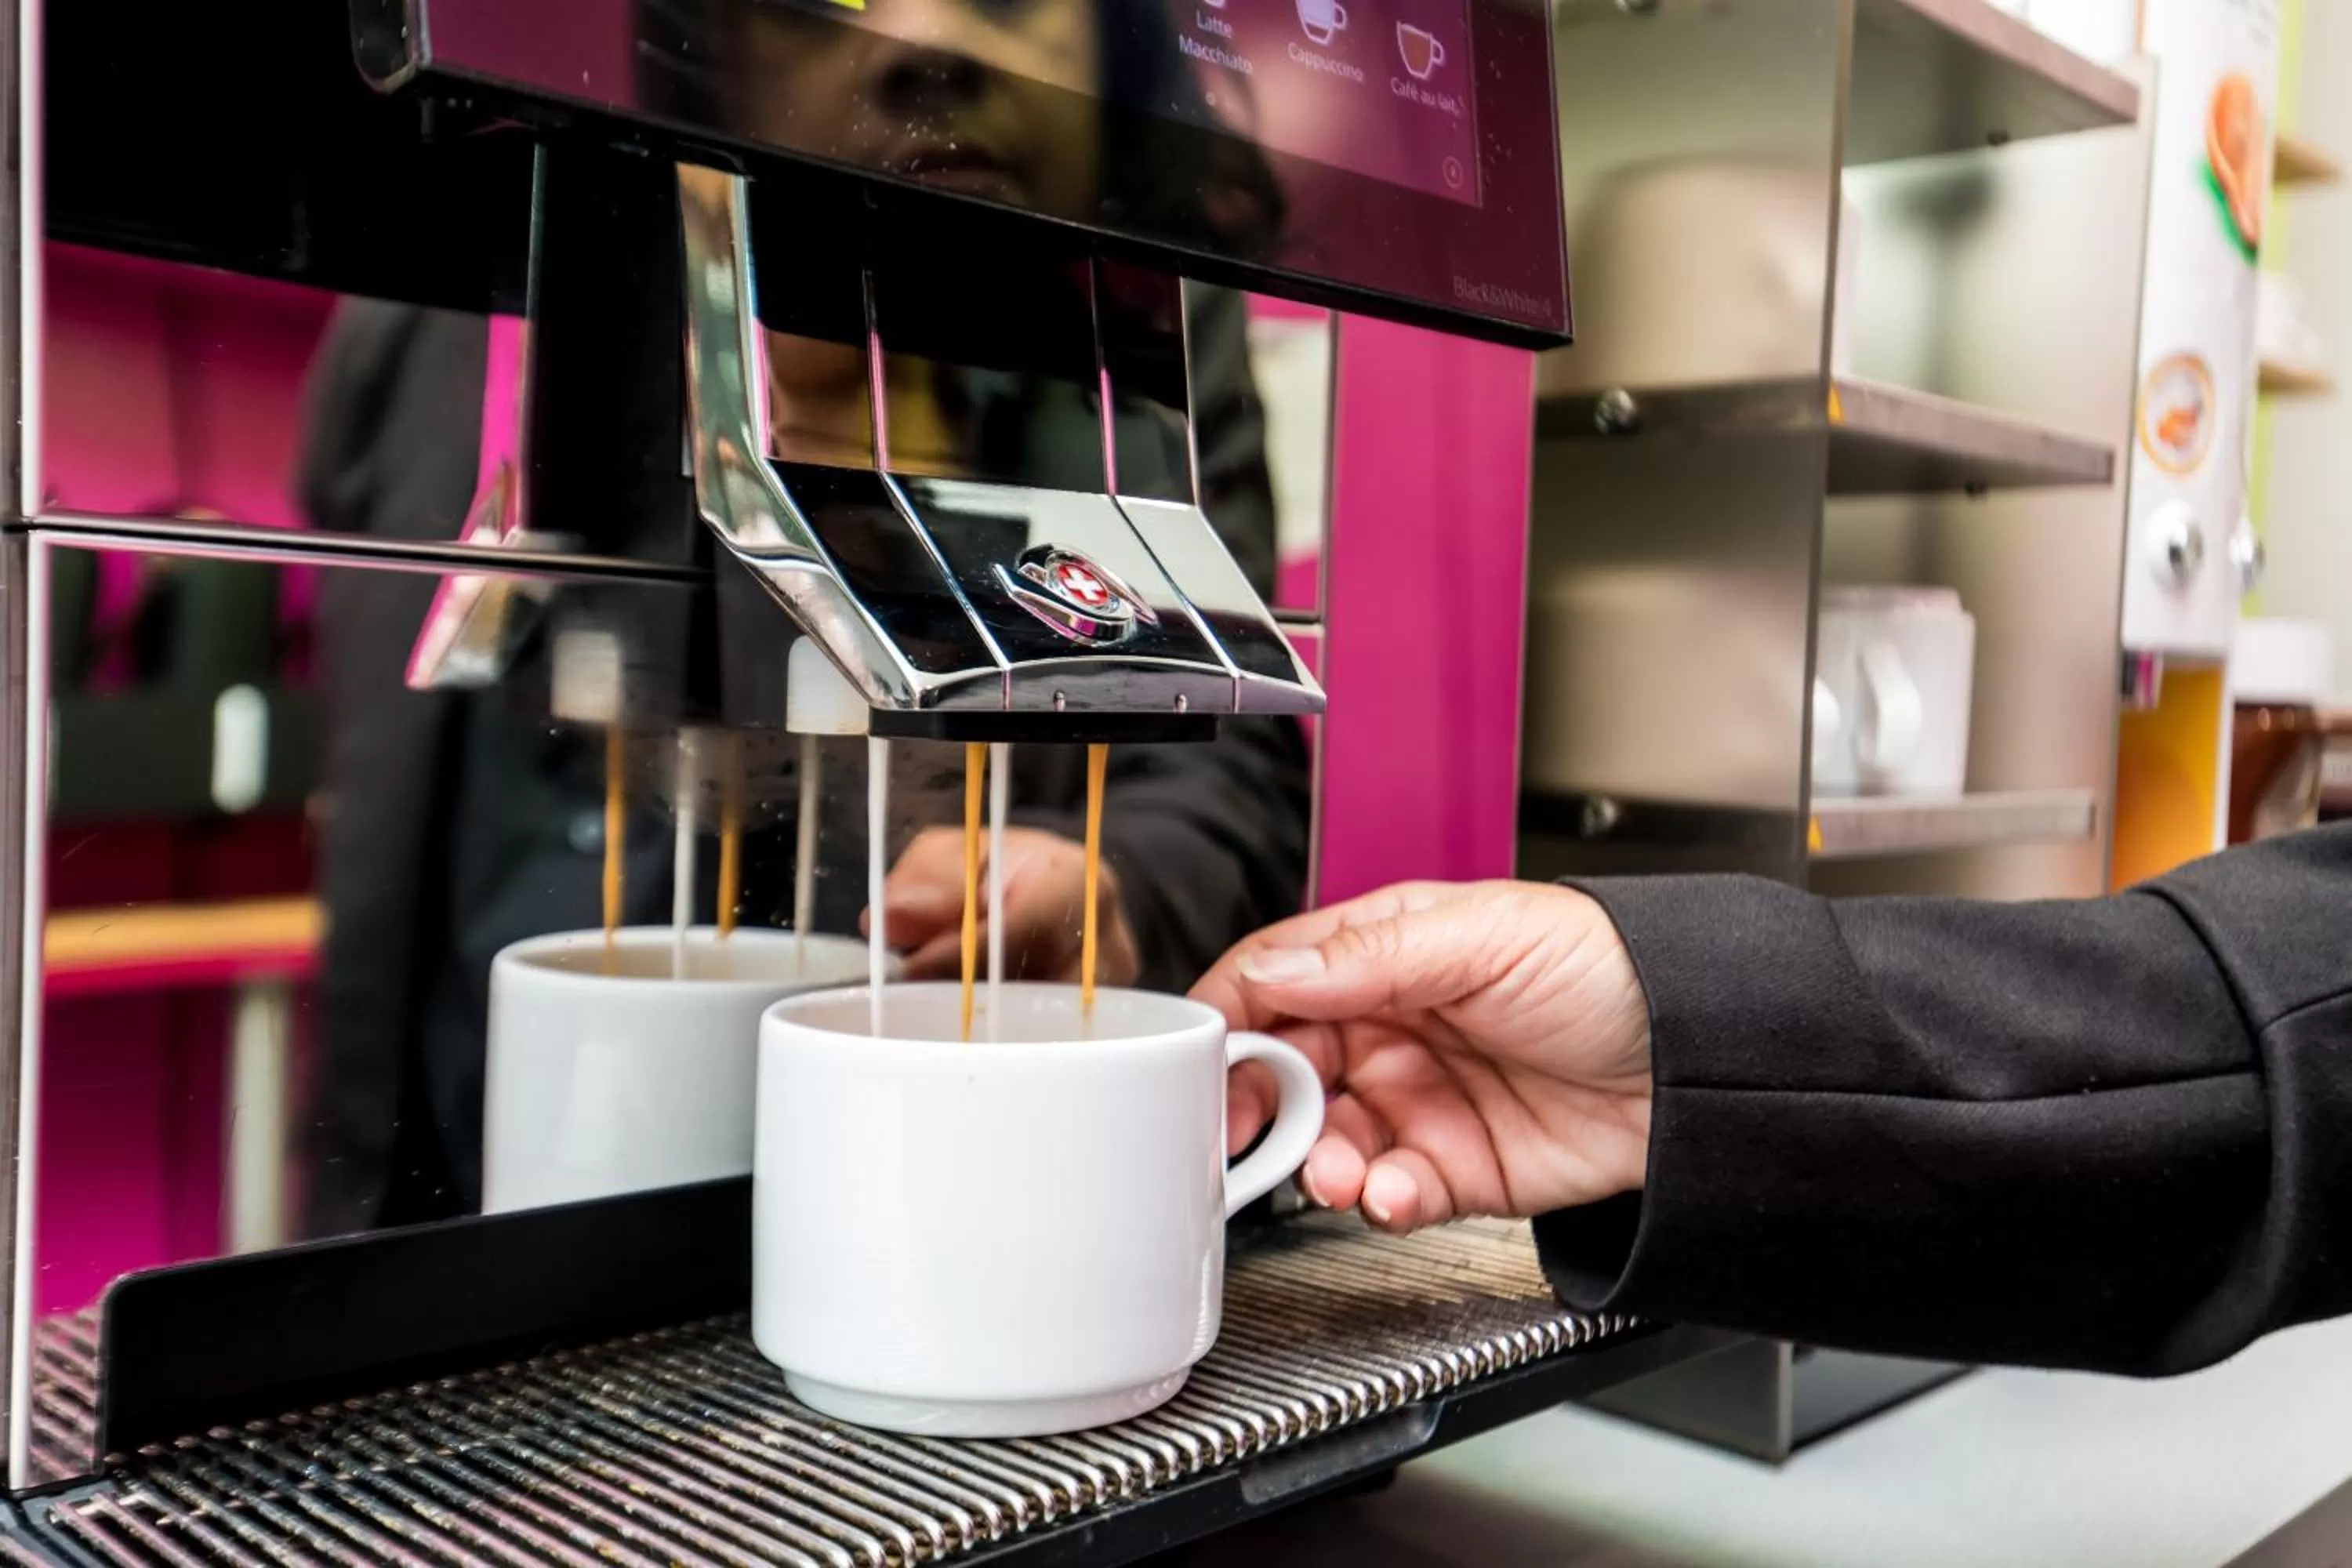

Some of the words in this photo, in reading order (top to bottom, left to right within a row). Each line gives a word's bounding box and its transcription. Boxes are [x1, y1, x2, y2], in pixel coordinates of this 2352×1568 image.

[1196, 9, 1232, 38] Latte
[1178, 34, 1254, 75] Macchiato
[1287, 42, 1364, 82] Cappuccino
[1390, 76, 1420, 102] Café
[1421, 90, 1436, 107] au
